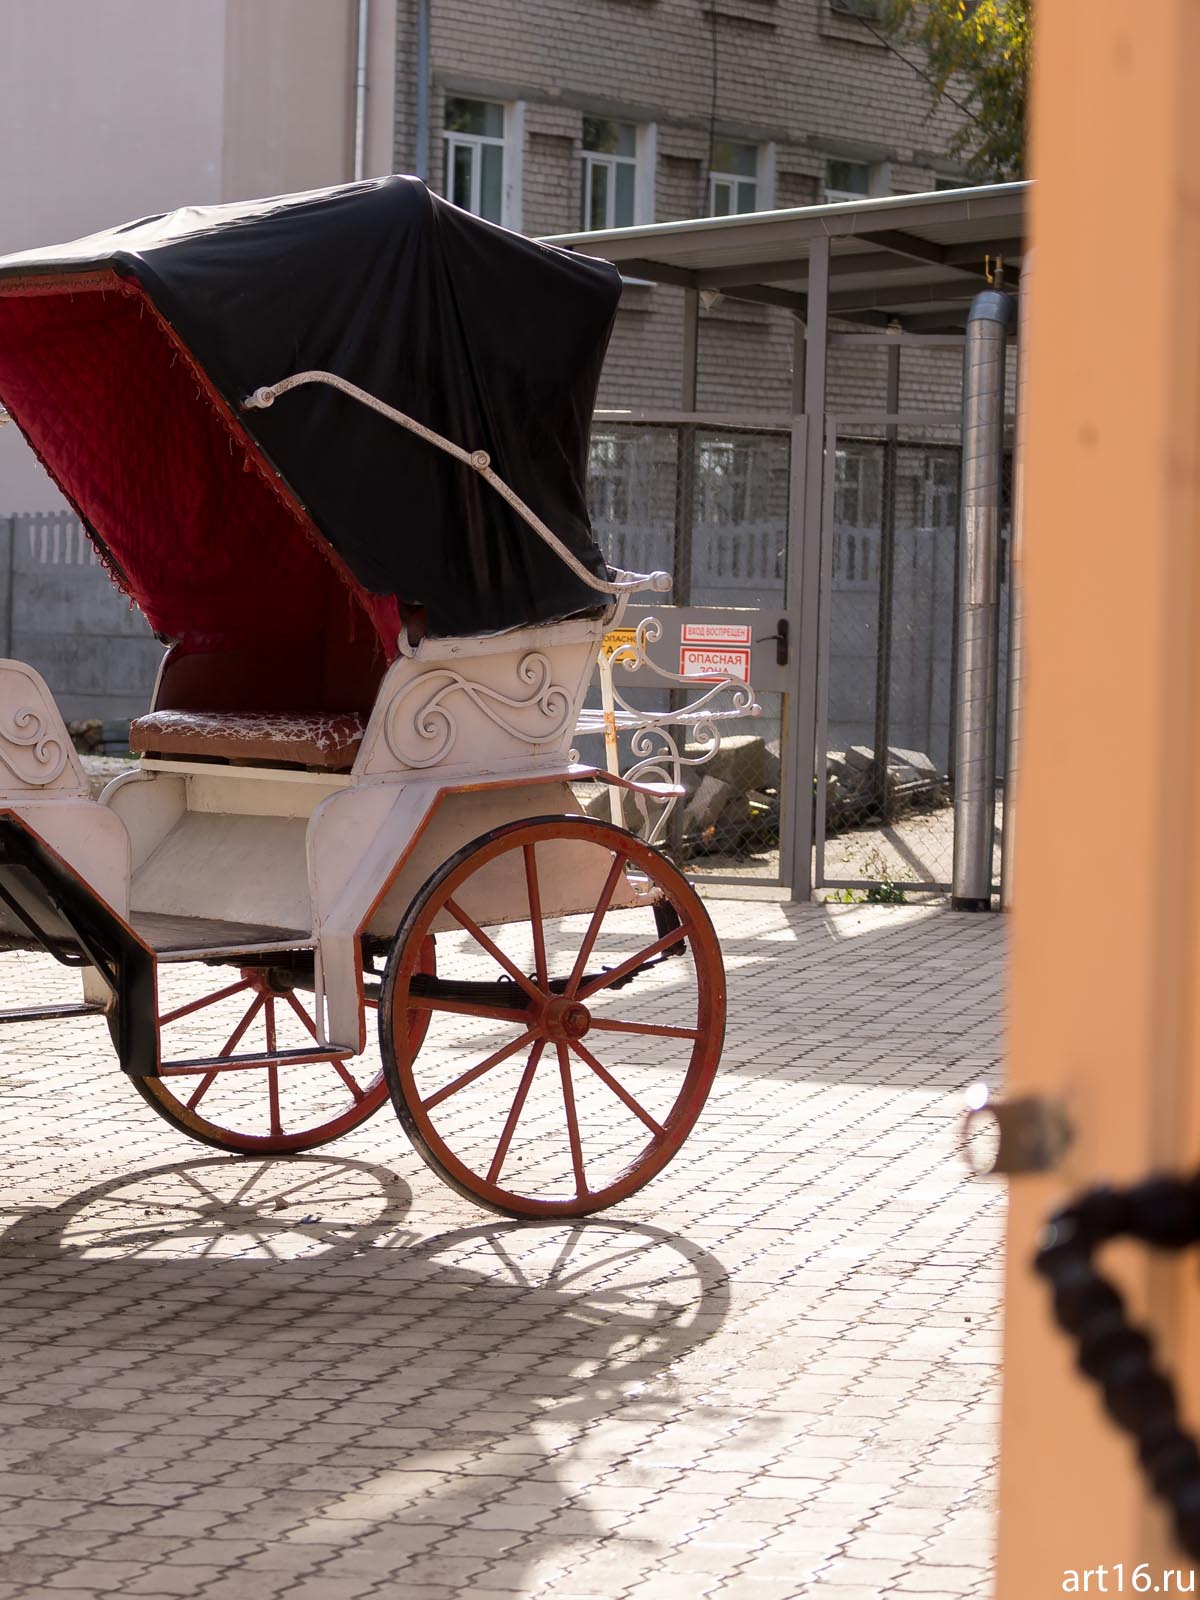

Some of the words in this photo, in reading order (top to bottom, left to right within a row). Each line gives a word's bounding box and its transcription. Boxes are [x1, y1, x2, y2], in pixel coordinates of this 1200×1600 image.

[688, 627, 704, 636] ВХОД
[706, 627, 745, 637] ВОСПРЕЩЕН
[688, 653, 742, 665] ОПАСНАЯ
